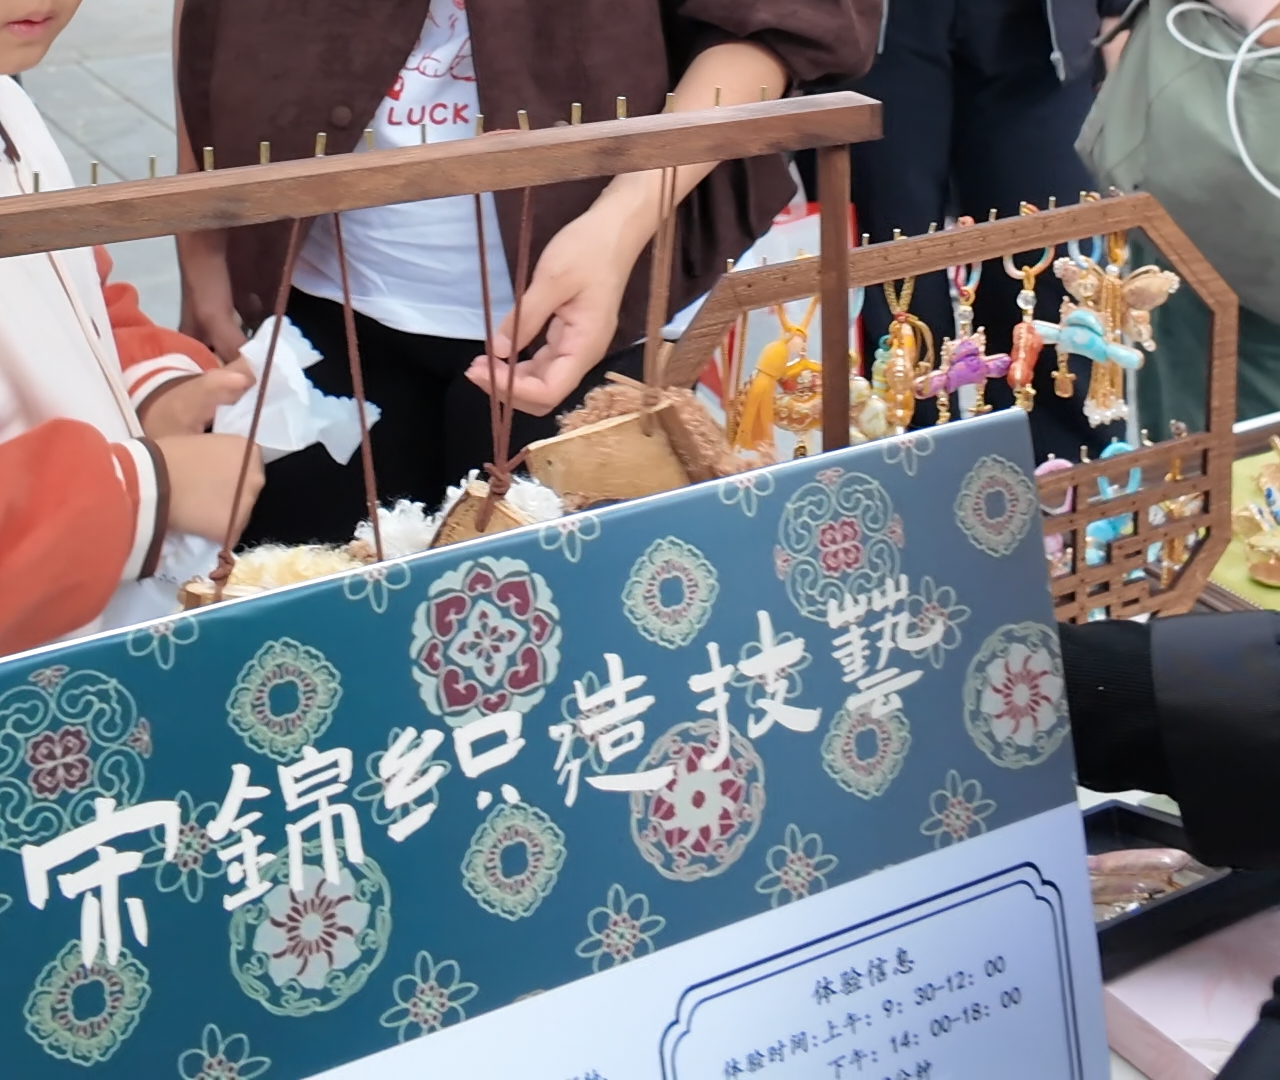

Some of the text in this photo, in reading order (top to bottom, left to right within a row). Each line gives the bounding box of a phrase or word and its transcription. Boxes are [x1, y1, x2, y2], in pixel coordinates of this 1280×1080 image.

[387, 102, 470, 126] LUCK
[813, 946, 915, 1005] 体验信息
